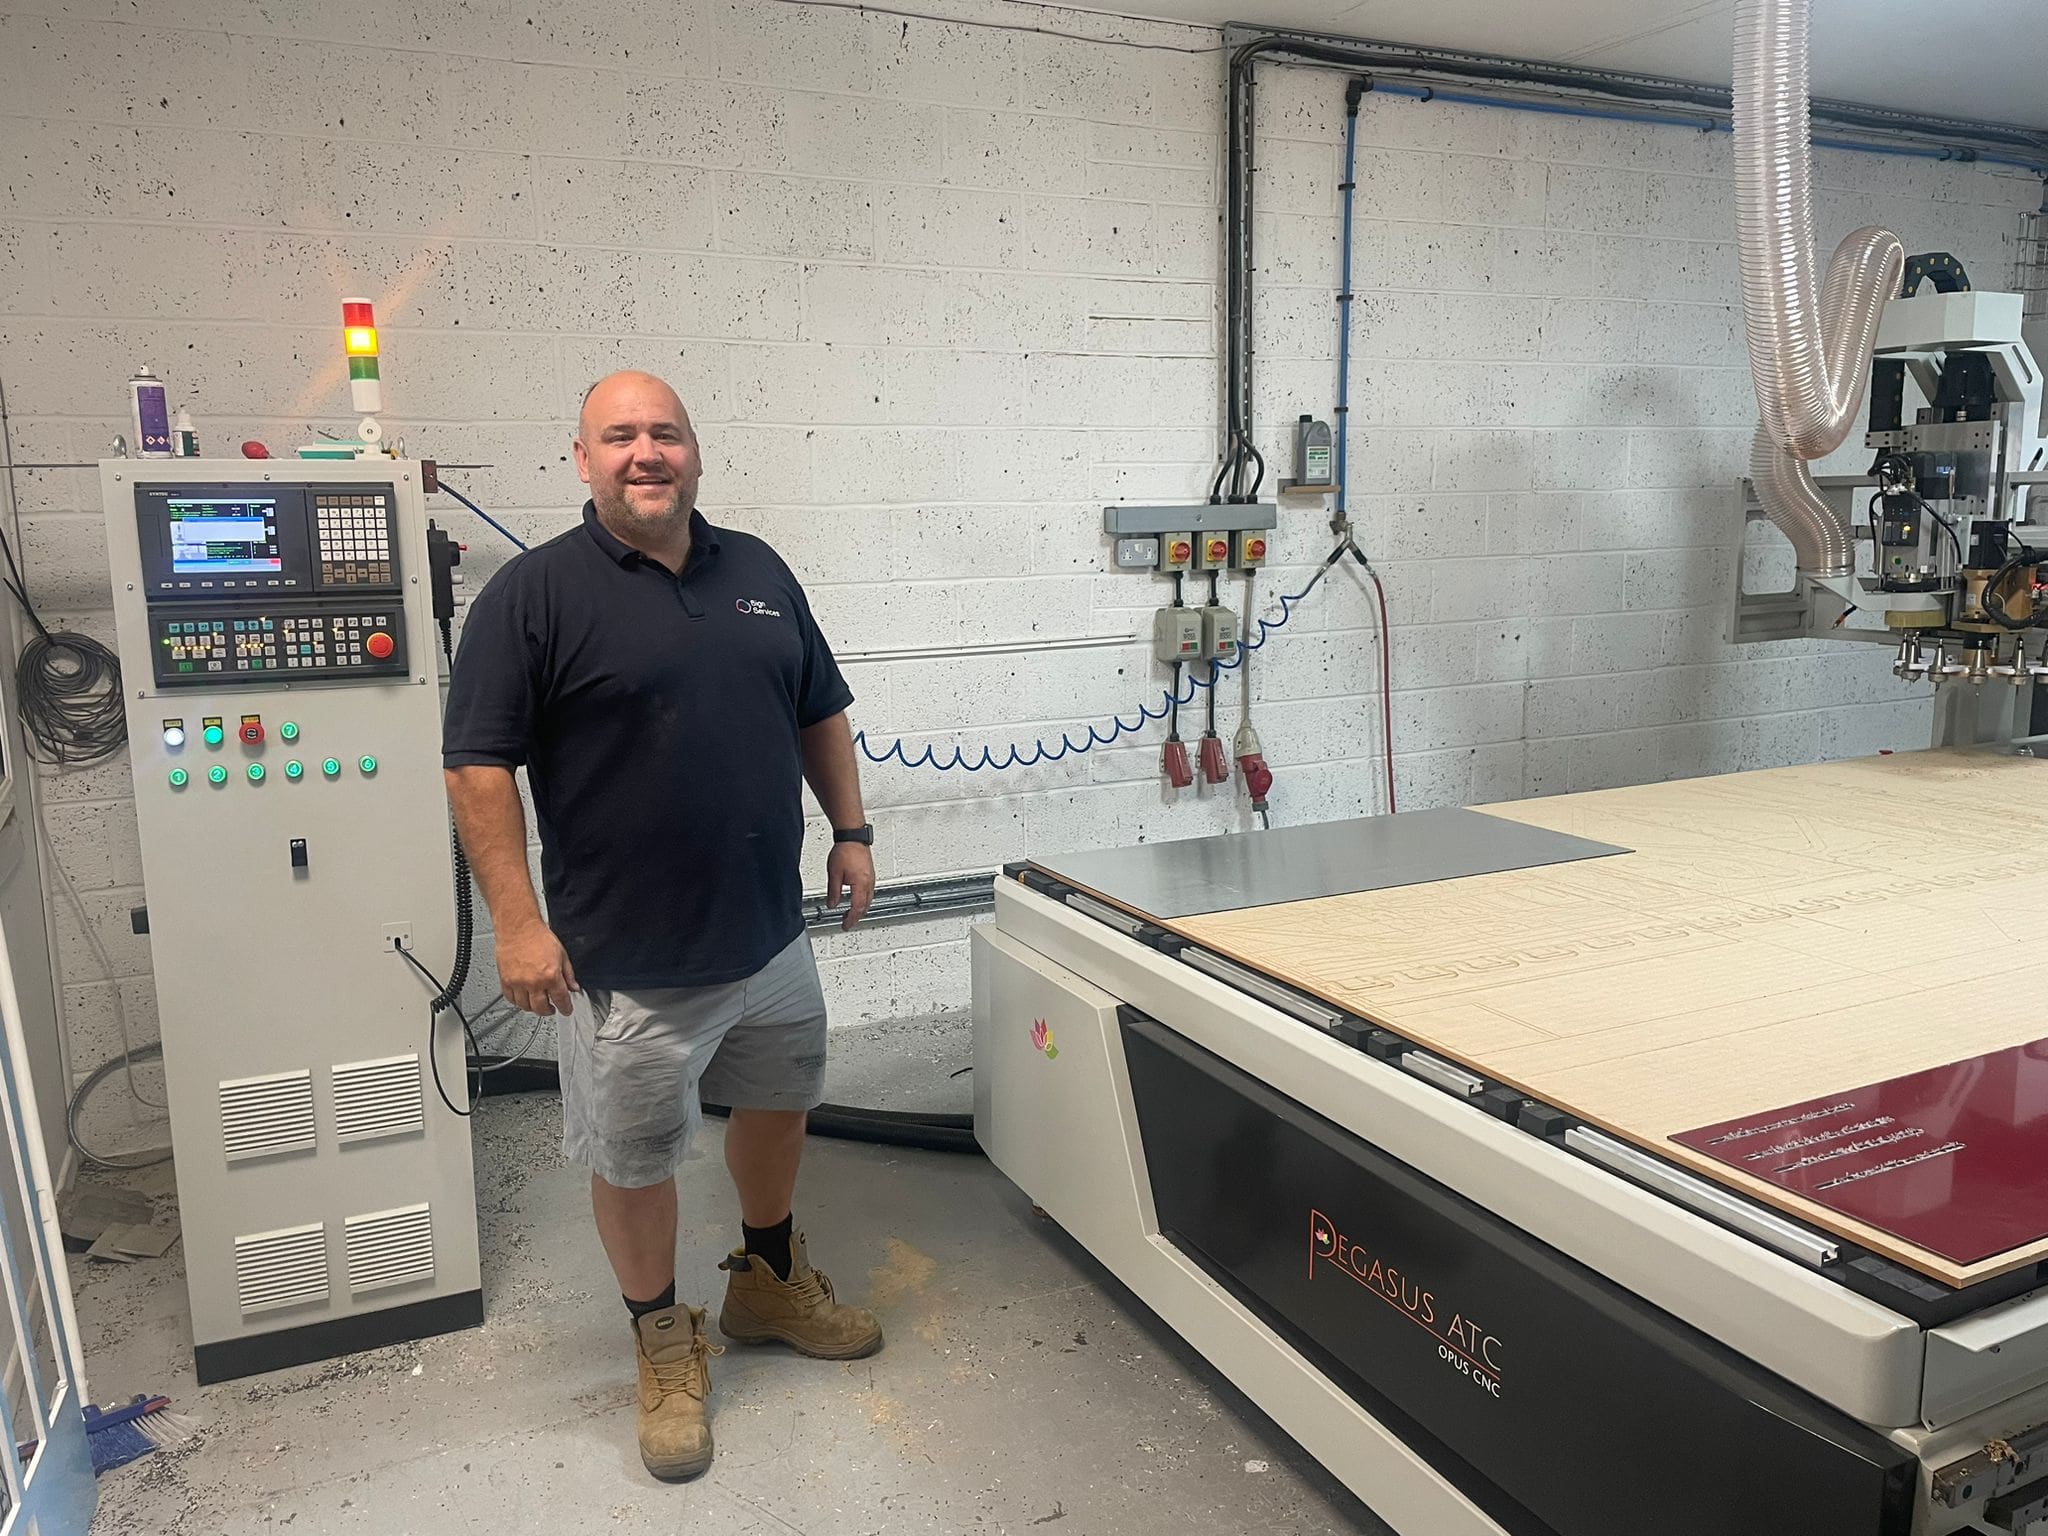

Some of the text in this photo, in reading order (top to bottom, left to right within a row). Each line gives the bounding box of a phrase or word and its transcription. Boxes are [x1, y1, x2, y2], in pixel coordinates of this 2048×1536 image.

[750, 600, 766, 608] Sign
[753, 606, 780, 617] Services
[1309, 1208, 1503, 1372] PEGASUS ATC
[1438, 1344, 1501, 1398] OPUS CNC
